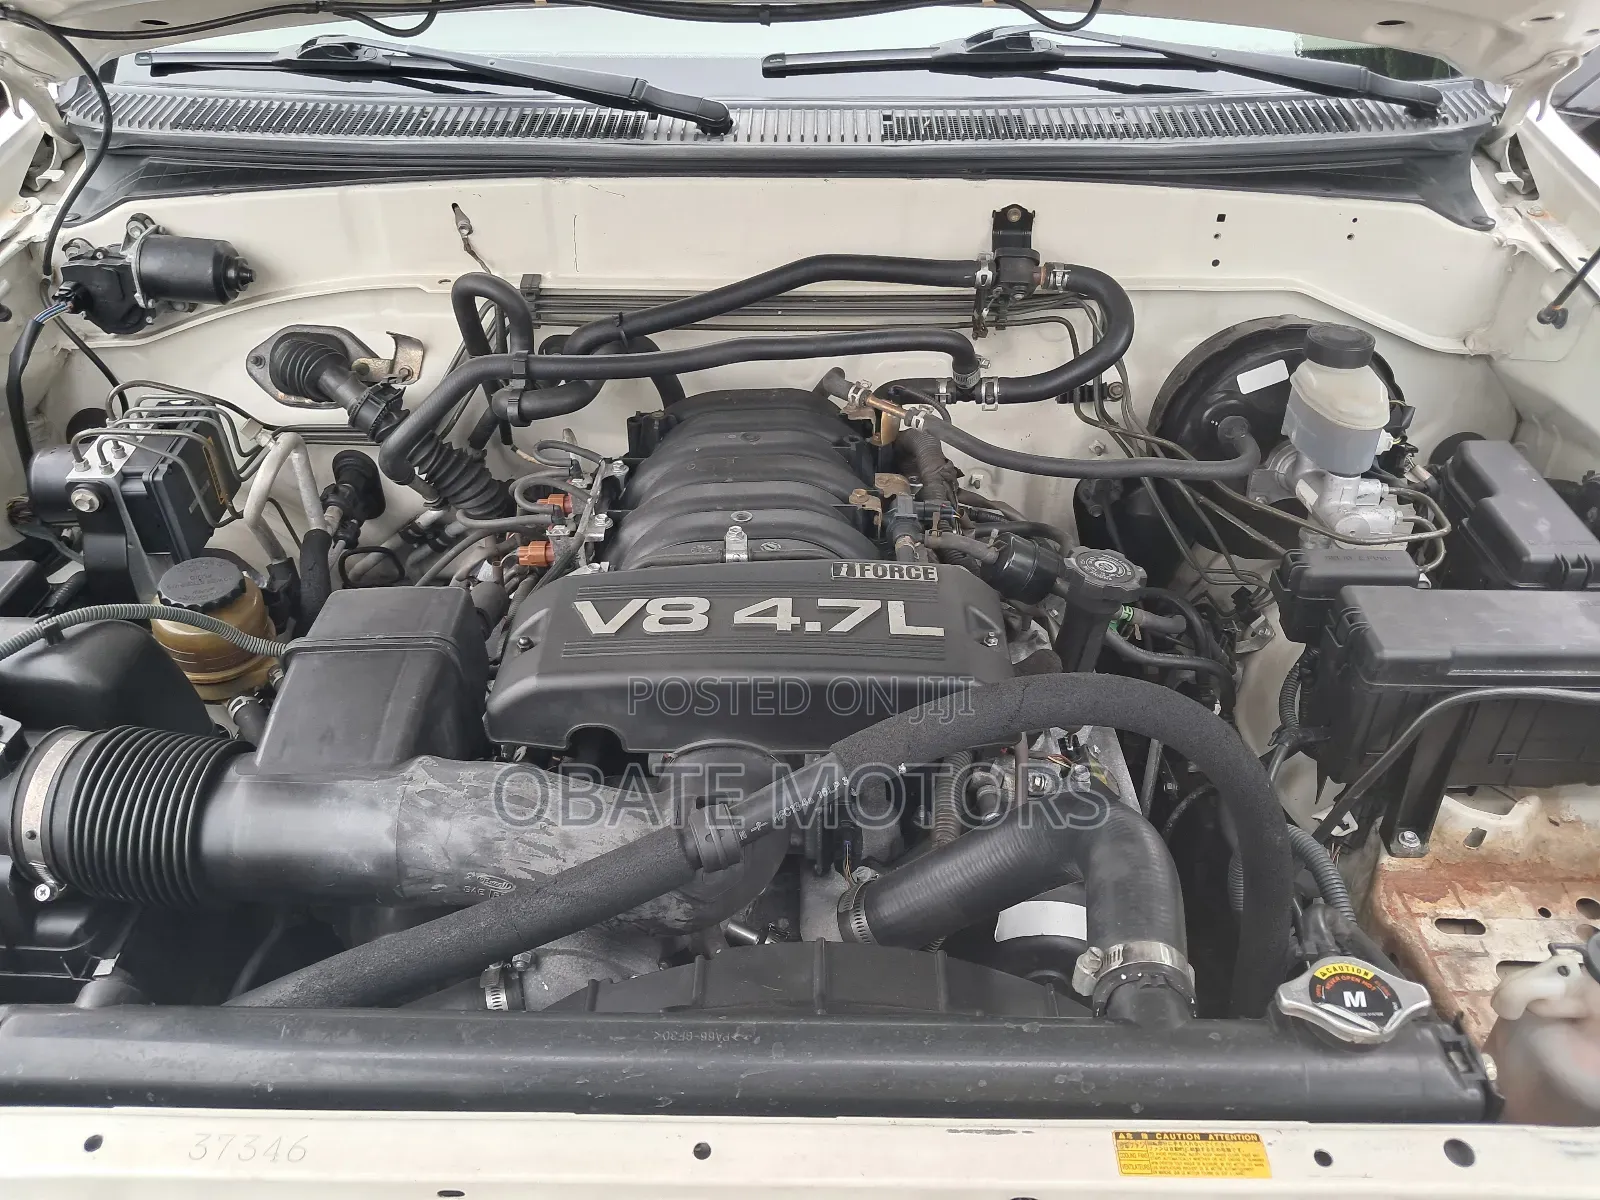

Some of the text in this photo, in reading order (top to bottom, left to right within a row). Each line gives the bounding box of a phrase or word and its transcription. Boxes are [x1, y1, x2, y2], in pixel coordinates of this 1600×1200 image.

[573, 596, 945, 638] V8 4.7L
[1326, 966, 1370, 977] CAUTION
[1343, 991, 1367, 1008] M
[1156, 1133, 1201, 1141] CAUTION
[1208, 1134, 1259, 1142] ATTENTION
[188, 1133, 309, 1163] 37346
